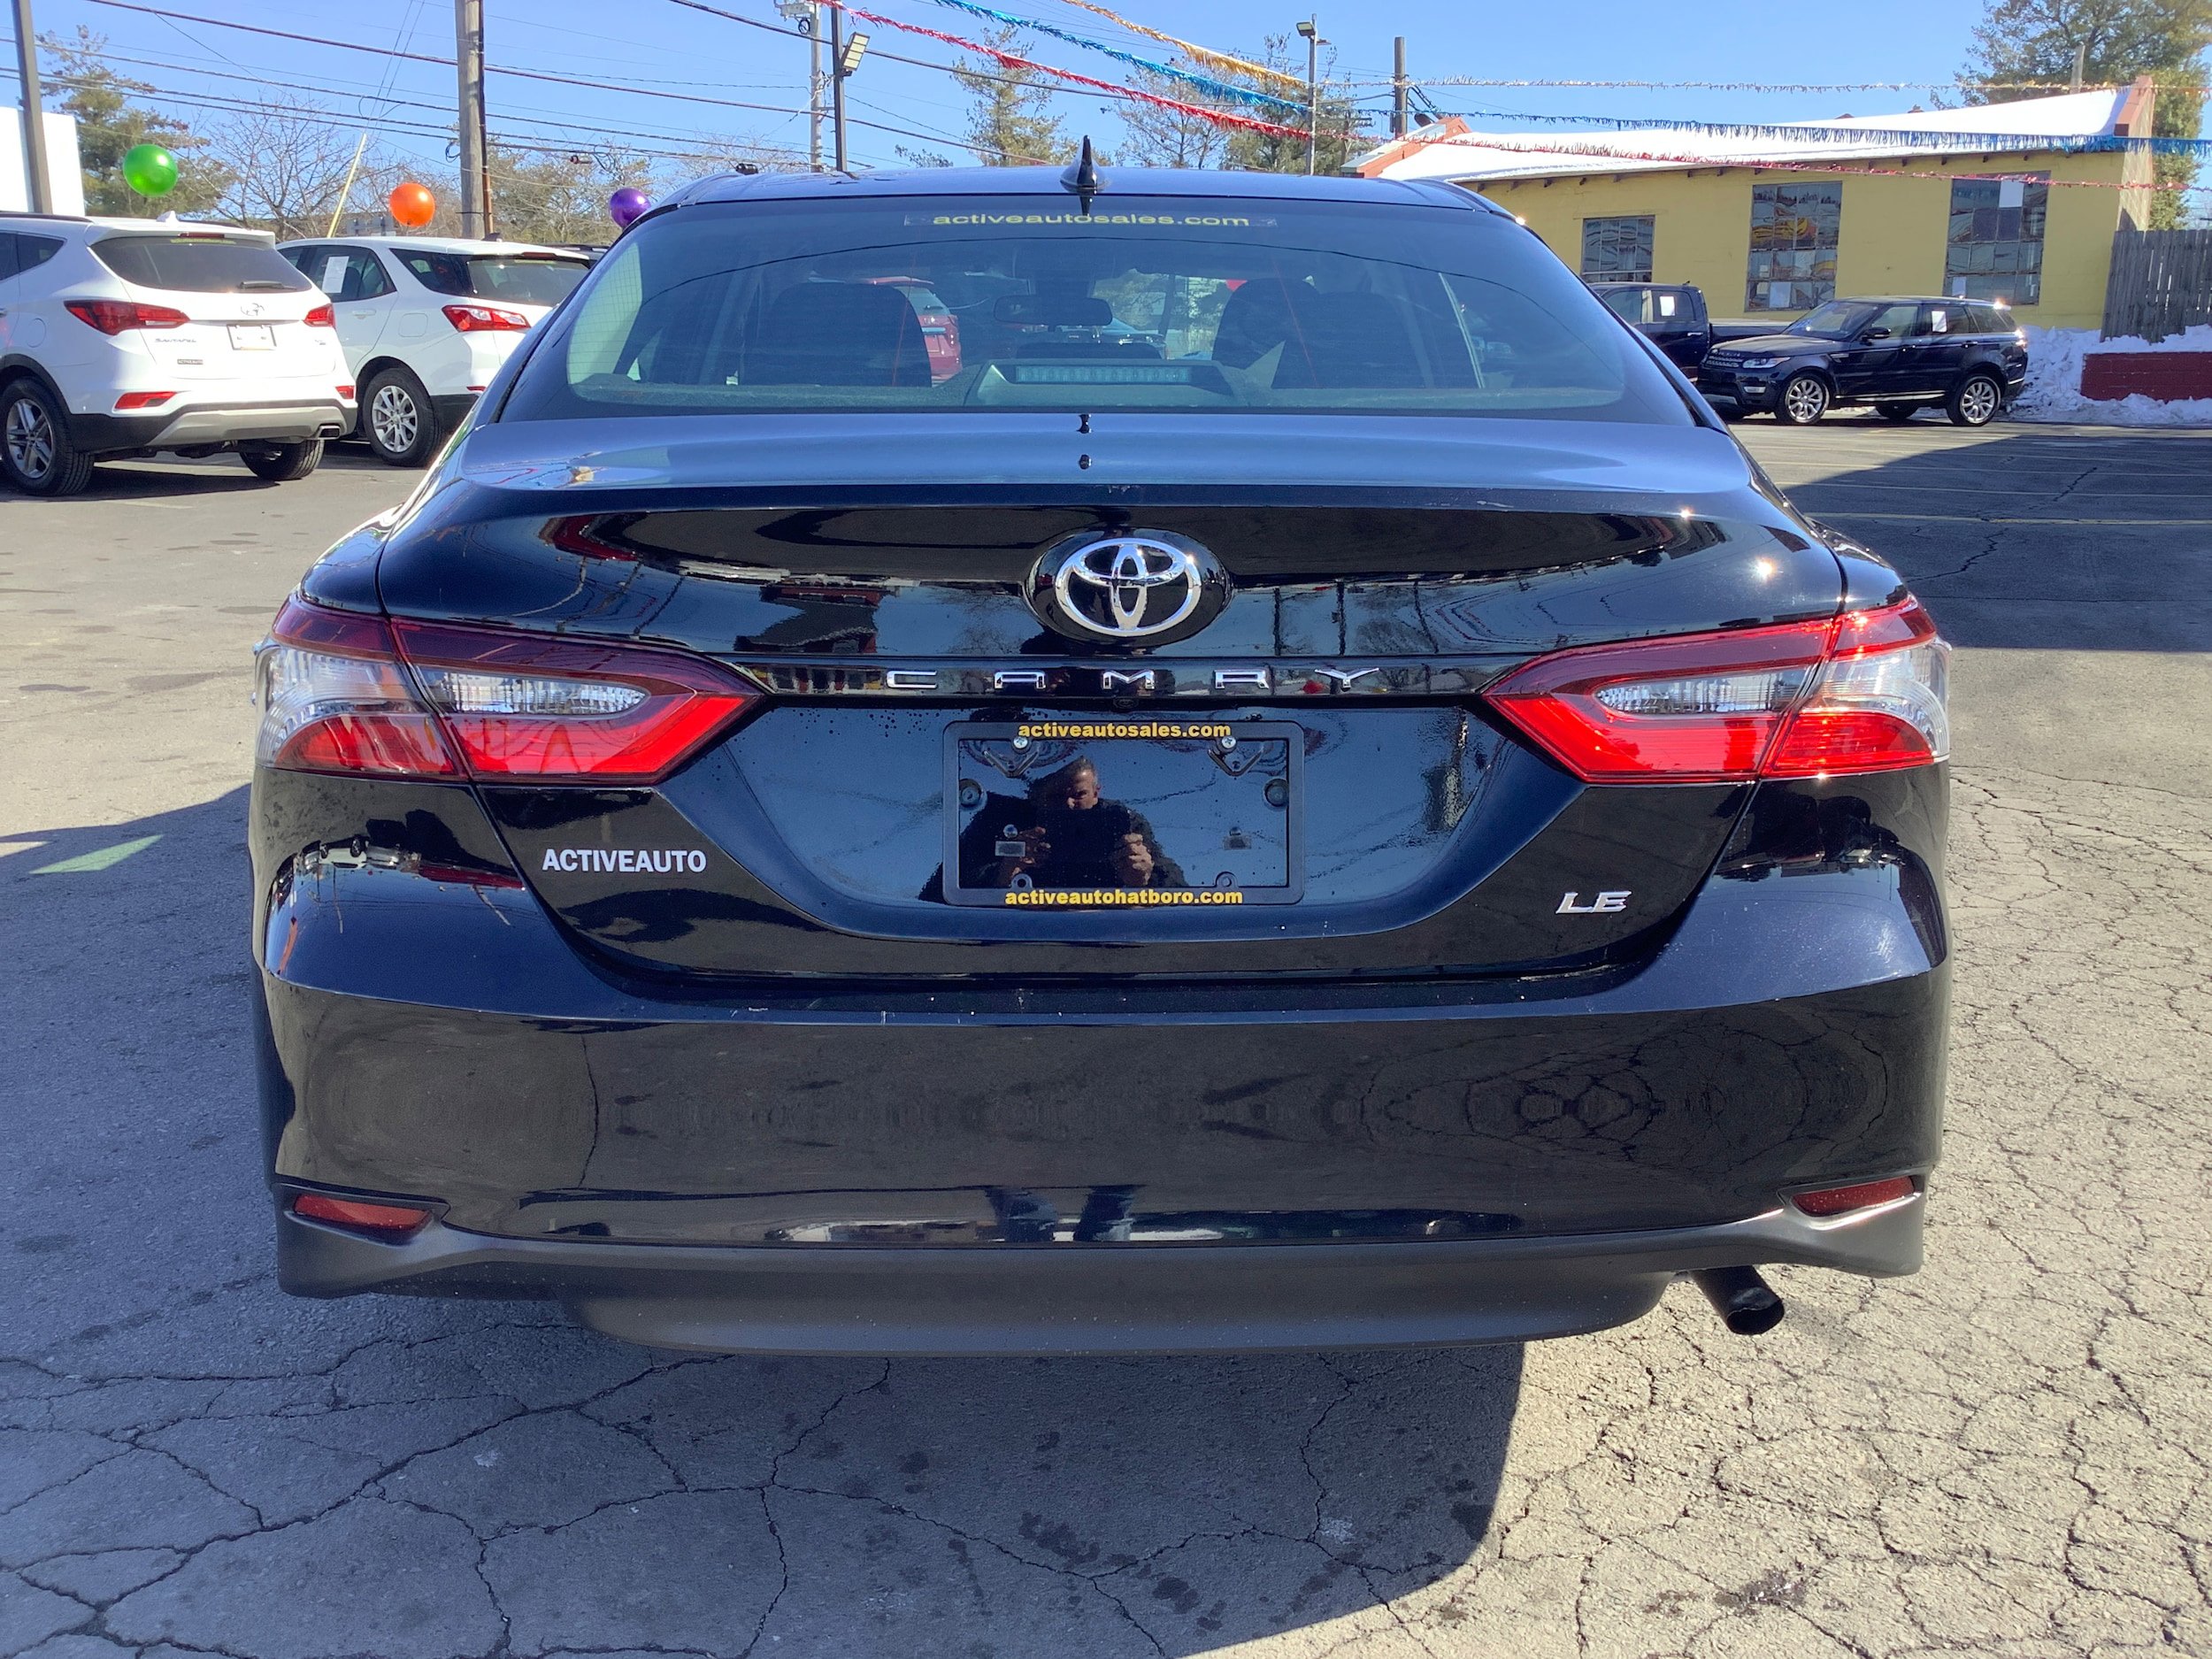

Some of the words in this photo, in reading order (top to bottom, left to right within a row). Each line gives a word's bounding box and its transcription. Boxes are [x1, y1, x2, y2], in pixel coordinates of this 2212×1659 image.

[933, 213, 1250, 227] activeautosales.com
[886, 668, 1379, 689] CAMRY
[1018, 722, 1232, 739] activeautosales.com
[541, 849, 707, 872] ACTIVEAUTO
[1004, 888, 1243, 905] activeautohatboro.com
[1555, 890, 1632, 914] LE
